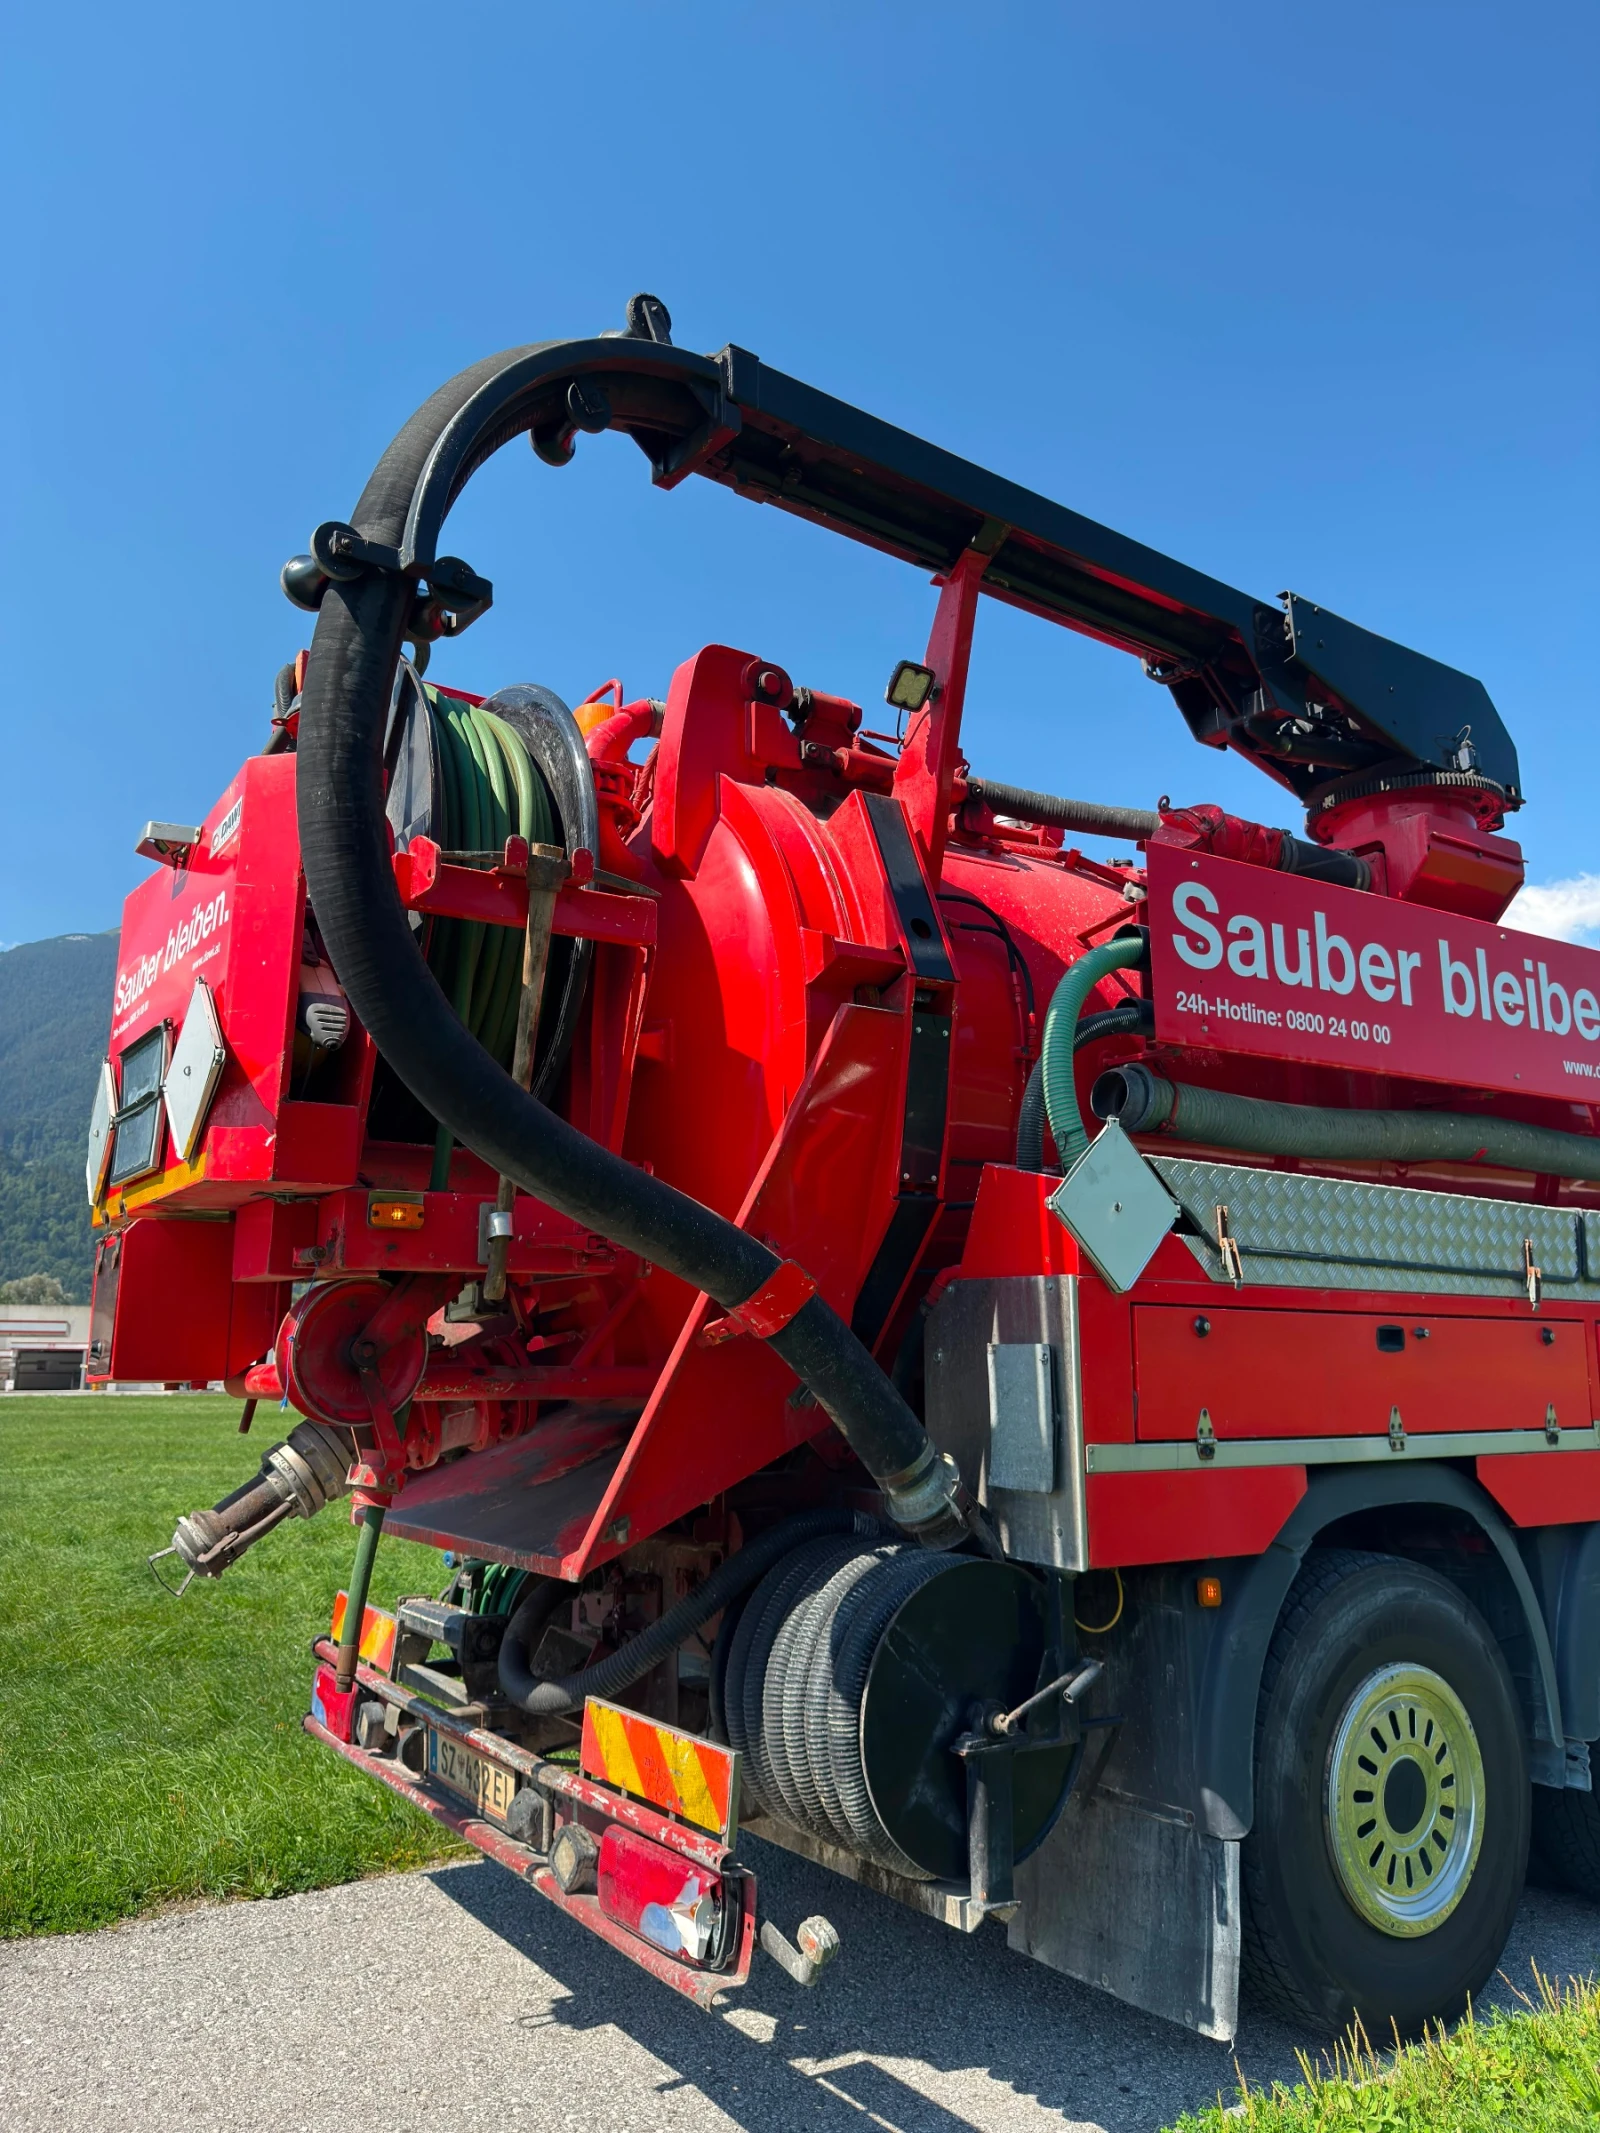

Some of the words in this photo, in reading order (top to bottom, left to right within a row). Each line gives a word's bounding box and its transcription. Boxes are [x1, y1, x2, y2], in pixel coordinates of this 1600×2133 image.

[115, 946, 164, 1016] Sauber
[163, 890, 229, 973] bleiben.
[1171, 881, 1421, 1007] Sauber
[1176, 990, 1282, 1028] 24h-Hotline:
[1286, 1009, 1325, 1035] 0800
[1328, 1016, 1348, 1038] 24
[1350, 1020, 1369, 1041] 00
[1372, 1024, 1391, 1045] 00
